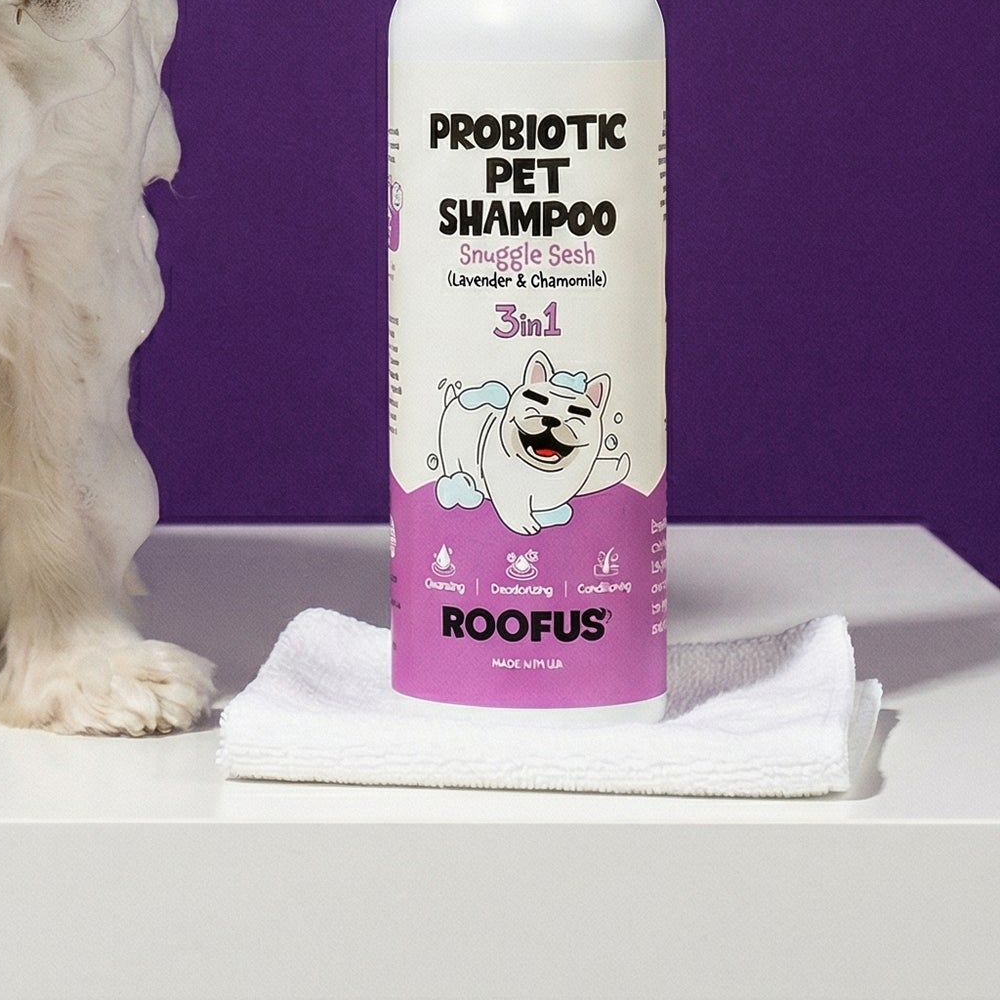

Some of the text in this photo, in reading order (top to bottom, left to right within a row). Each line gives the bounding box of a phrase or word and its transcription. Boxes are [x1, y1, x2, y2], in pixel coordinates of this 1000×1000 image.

[430, 113, 627, 150] PROBIOTIC
[486, 157, 570, 194] PET
[439, 198, 617, 236] SHAMPOO
[460, 241, 596, 272] Snuggle Sesh
[447, 270, 607, 289] (Lavender & Chamomile)
[493, 301, 562, 339] 3in1
[442, 606, 607, 642] ROOFUS
[491, 658, 521, 669] MADE
